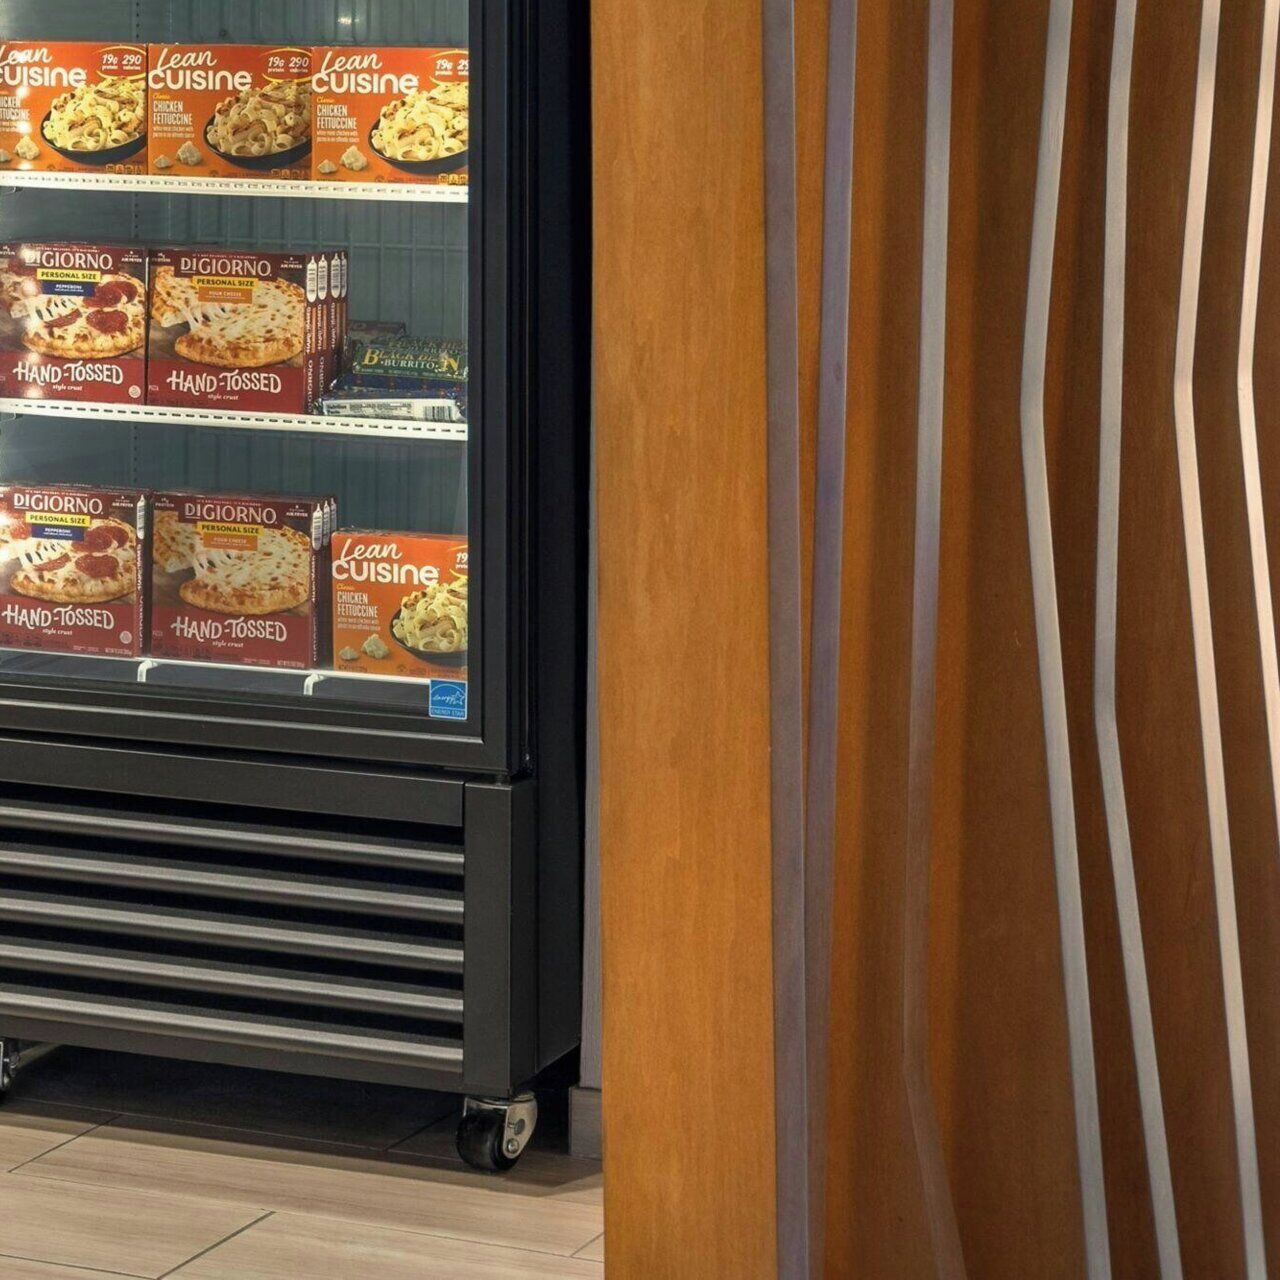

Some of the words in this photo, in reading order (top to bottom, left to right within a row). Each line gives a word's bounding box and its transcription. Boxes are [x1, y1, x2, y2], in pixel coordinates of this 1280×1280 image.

[122, 55, 142, 65] 290
[156, 48, 217, 73] Lean
[288, 57, 309, 68] 290
[320, 51, 382, 76] Lean
[153, 101, 183, 112] CHICKEN
[317, 105, 347, 116] CHICKEN
[153, 114, 192, 125] FETTUCCINE
[317, 118, 357, 129] FETTUCCINE
[181, 258, 272, 277] DIGIORNO
[197, 278, 236, 286] PERSONAL
[384, 360, 435, 370] BURRITO
[13, 360, 123, 385] HAND-TOSSED
[166, 369, 282, 394] HAND-TOSSED
[13, 493, 104, 514] DIGIORNO
[30, 515, 69, 523] PERSONAL
[185, 503, 277, 524] DIGIORNO
[202, 524, 241, 533] PERSONAL
[243, 526, 259, 534] SIZE
[340, 538, 402, 562] Lean
[338, 591, 368, 603] CHICKEN
[1, 604, 115, 630] HAND-TOSSED
[338, 605, 379, 618] FETTUCCINE
[171, 616, 287, 642] HAND-TOSSED
